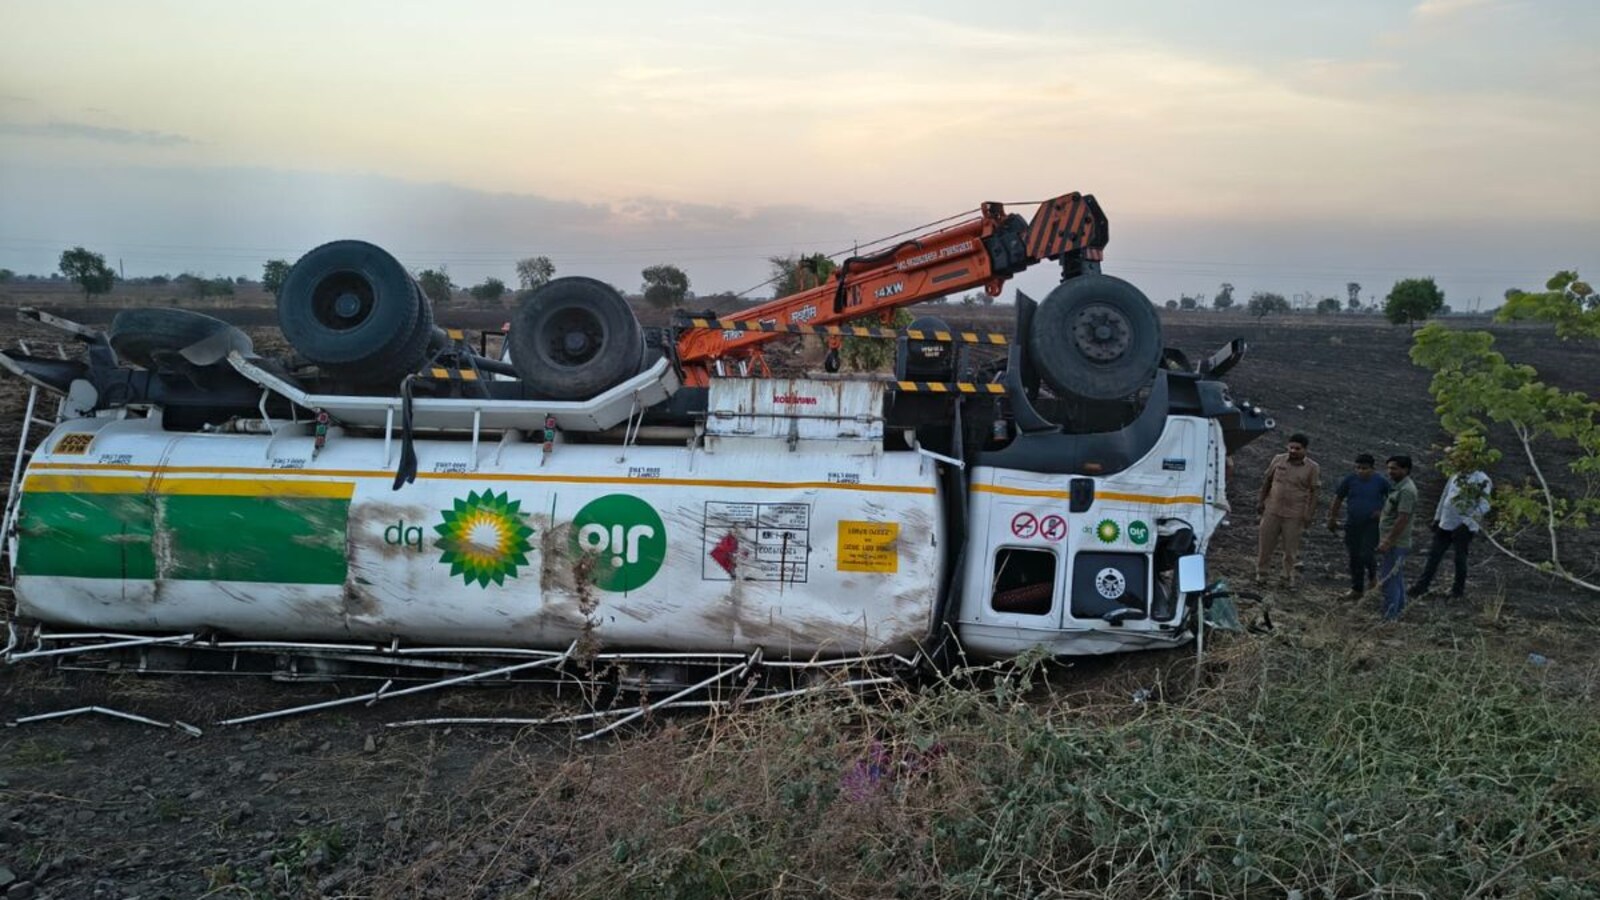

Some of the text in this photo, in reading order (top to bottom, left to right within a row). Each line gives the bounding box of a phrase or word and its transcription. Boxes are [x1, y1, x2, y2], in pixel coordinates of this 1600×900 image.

[874, 282, 904, 298] 14XW
[384, 519, 423, 552] bp
[578, 524, 654, 567] Jio
[1129, 528, 1147, 539] Jio
